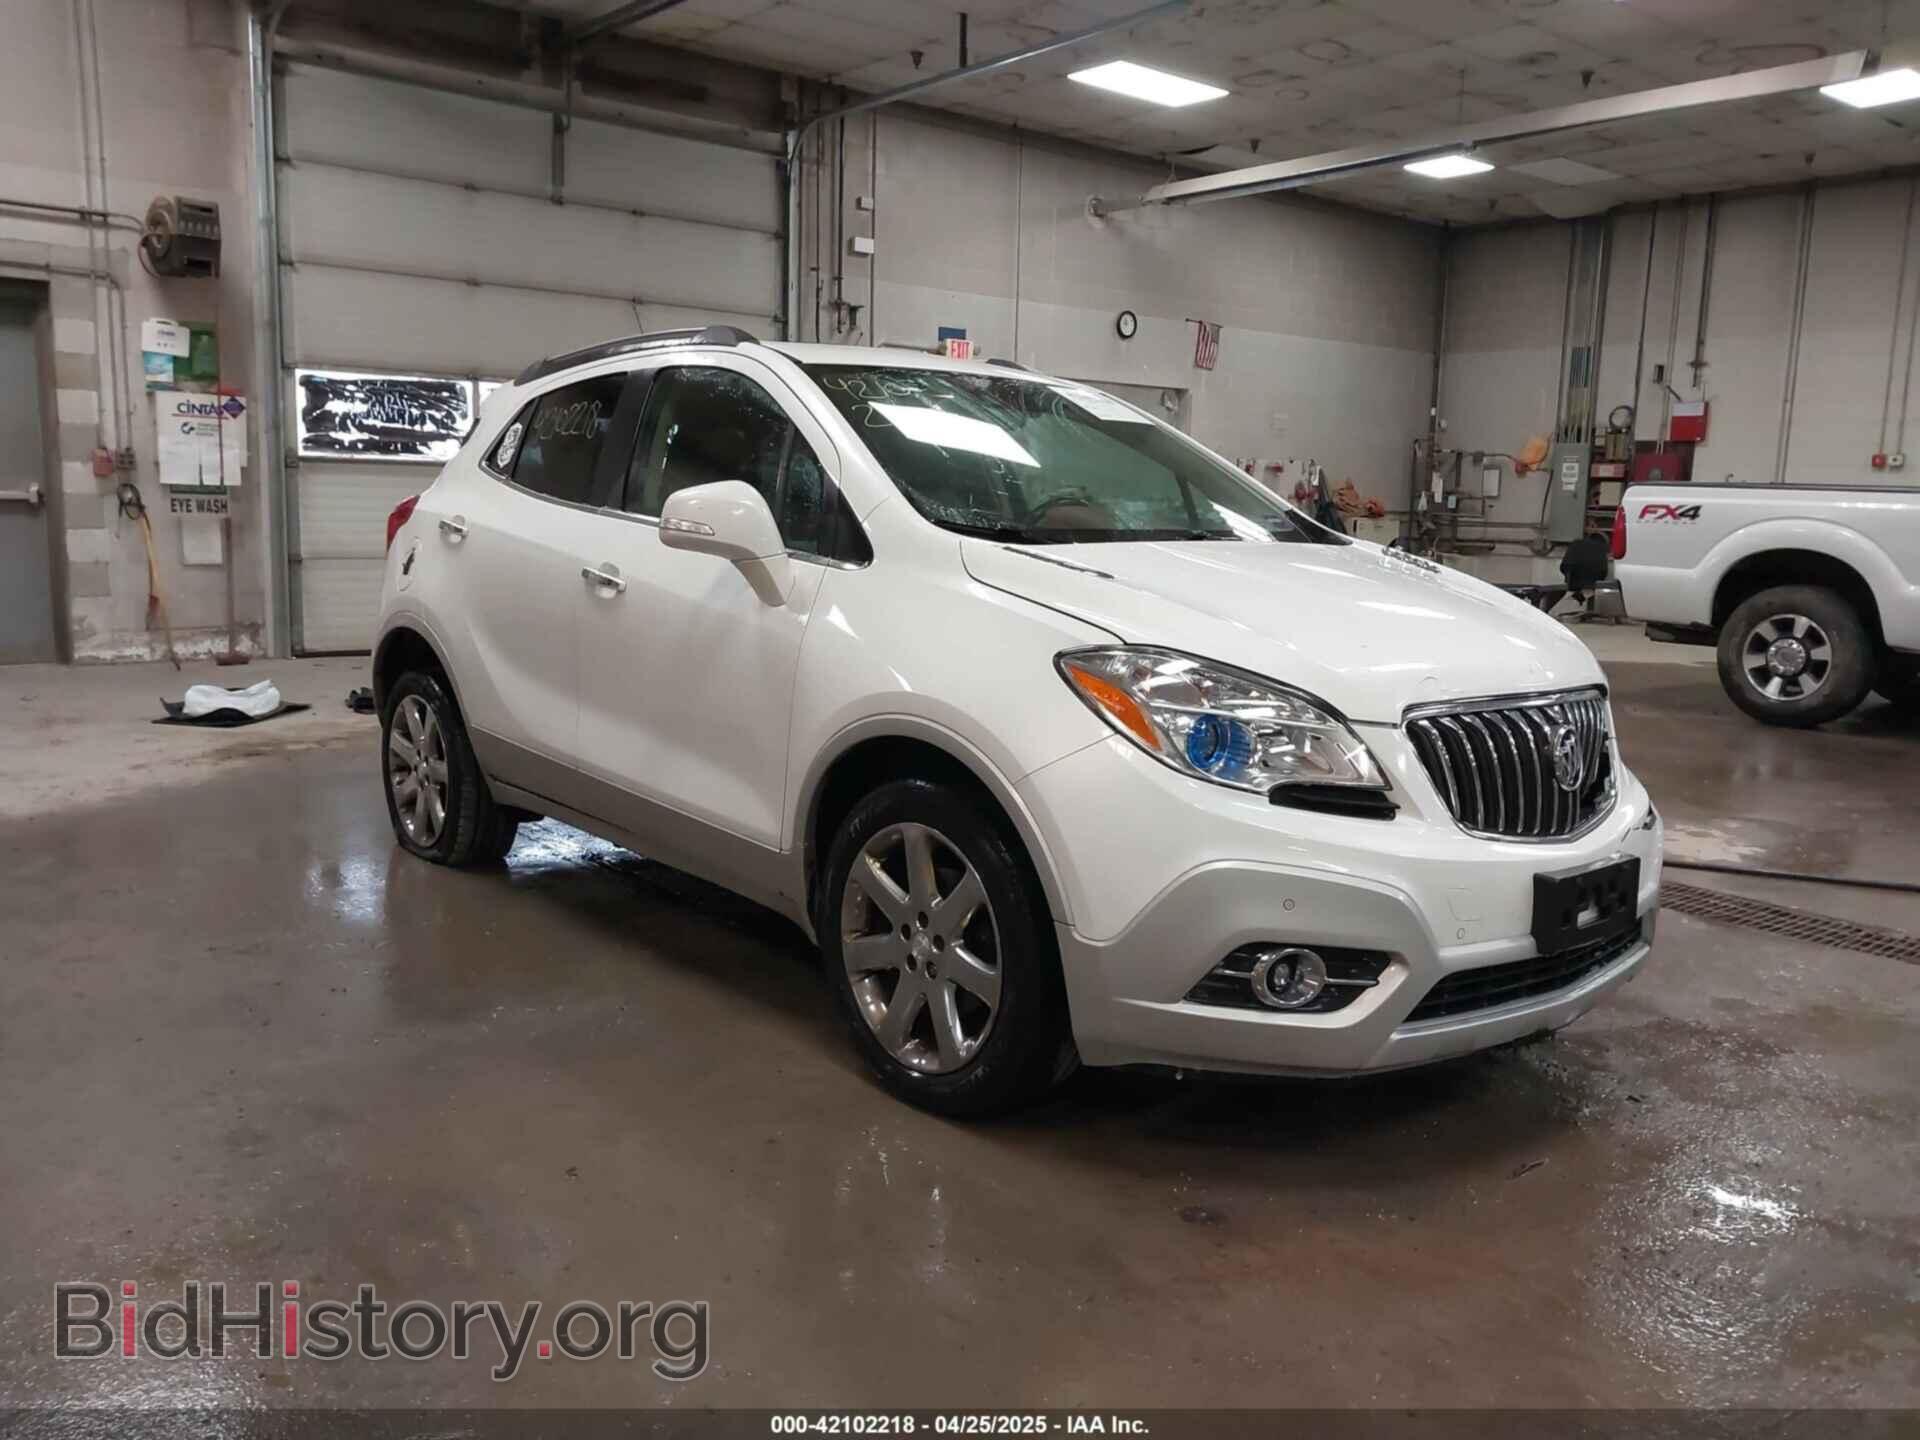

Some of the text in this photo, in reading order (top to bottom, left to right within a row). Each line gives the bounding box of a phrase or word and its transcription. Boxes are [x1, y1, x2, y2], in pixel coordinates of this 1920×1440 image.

[951, 340, 970, 359] EXIT
[170, 498, 229, 514] EYE WASH
[1638, 504, 1702, 520] FX4
